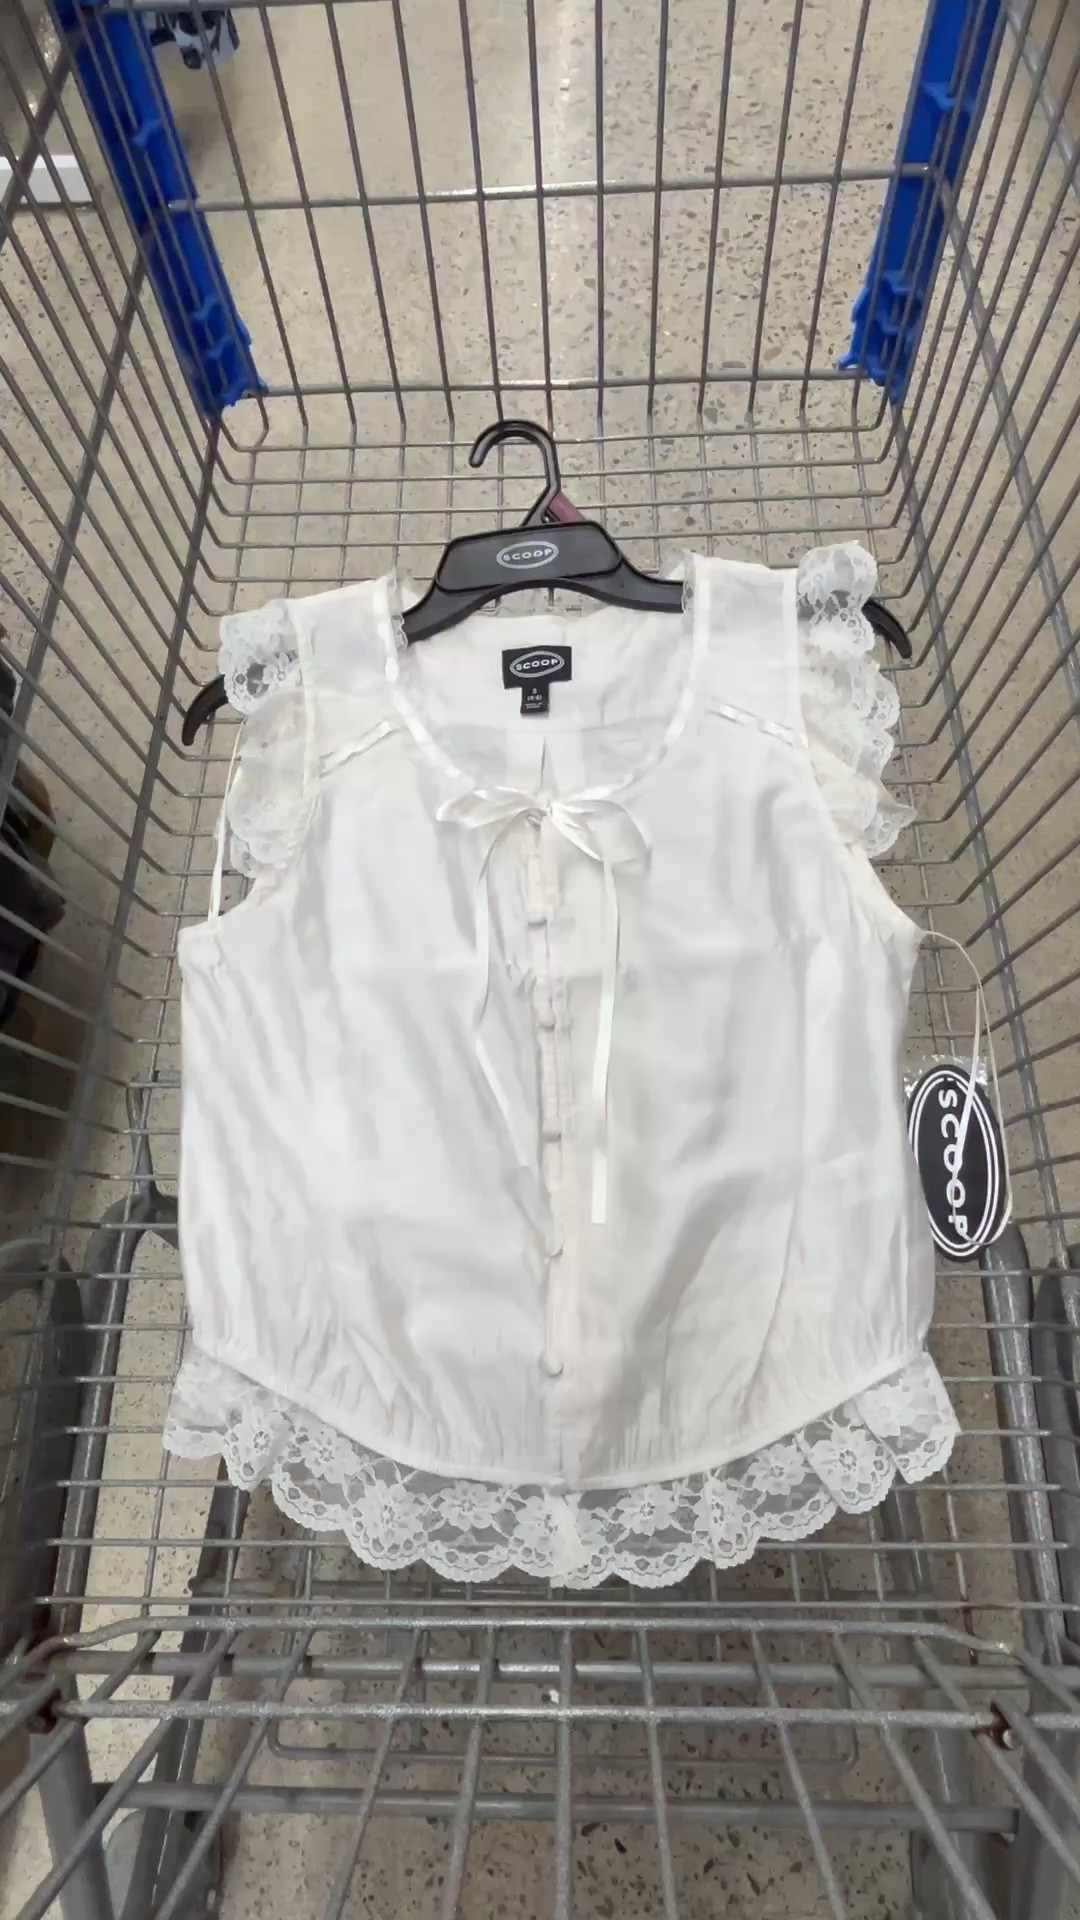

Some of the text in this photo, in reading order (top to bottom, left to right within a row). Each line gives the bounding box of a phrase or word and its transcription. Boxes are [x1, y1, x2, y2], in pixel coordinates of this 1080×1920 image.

[503, 548, 552, 561] SCOOP
[515, 658, 558, 671] SCOOP
[938, 1088, 968, 1236] SCOOP
